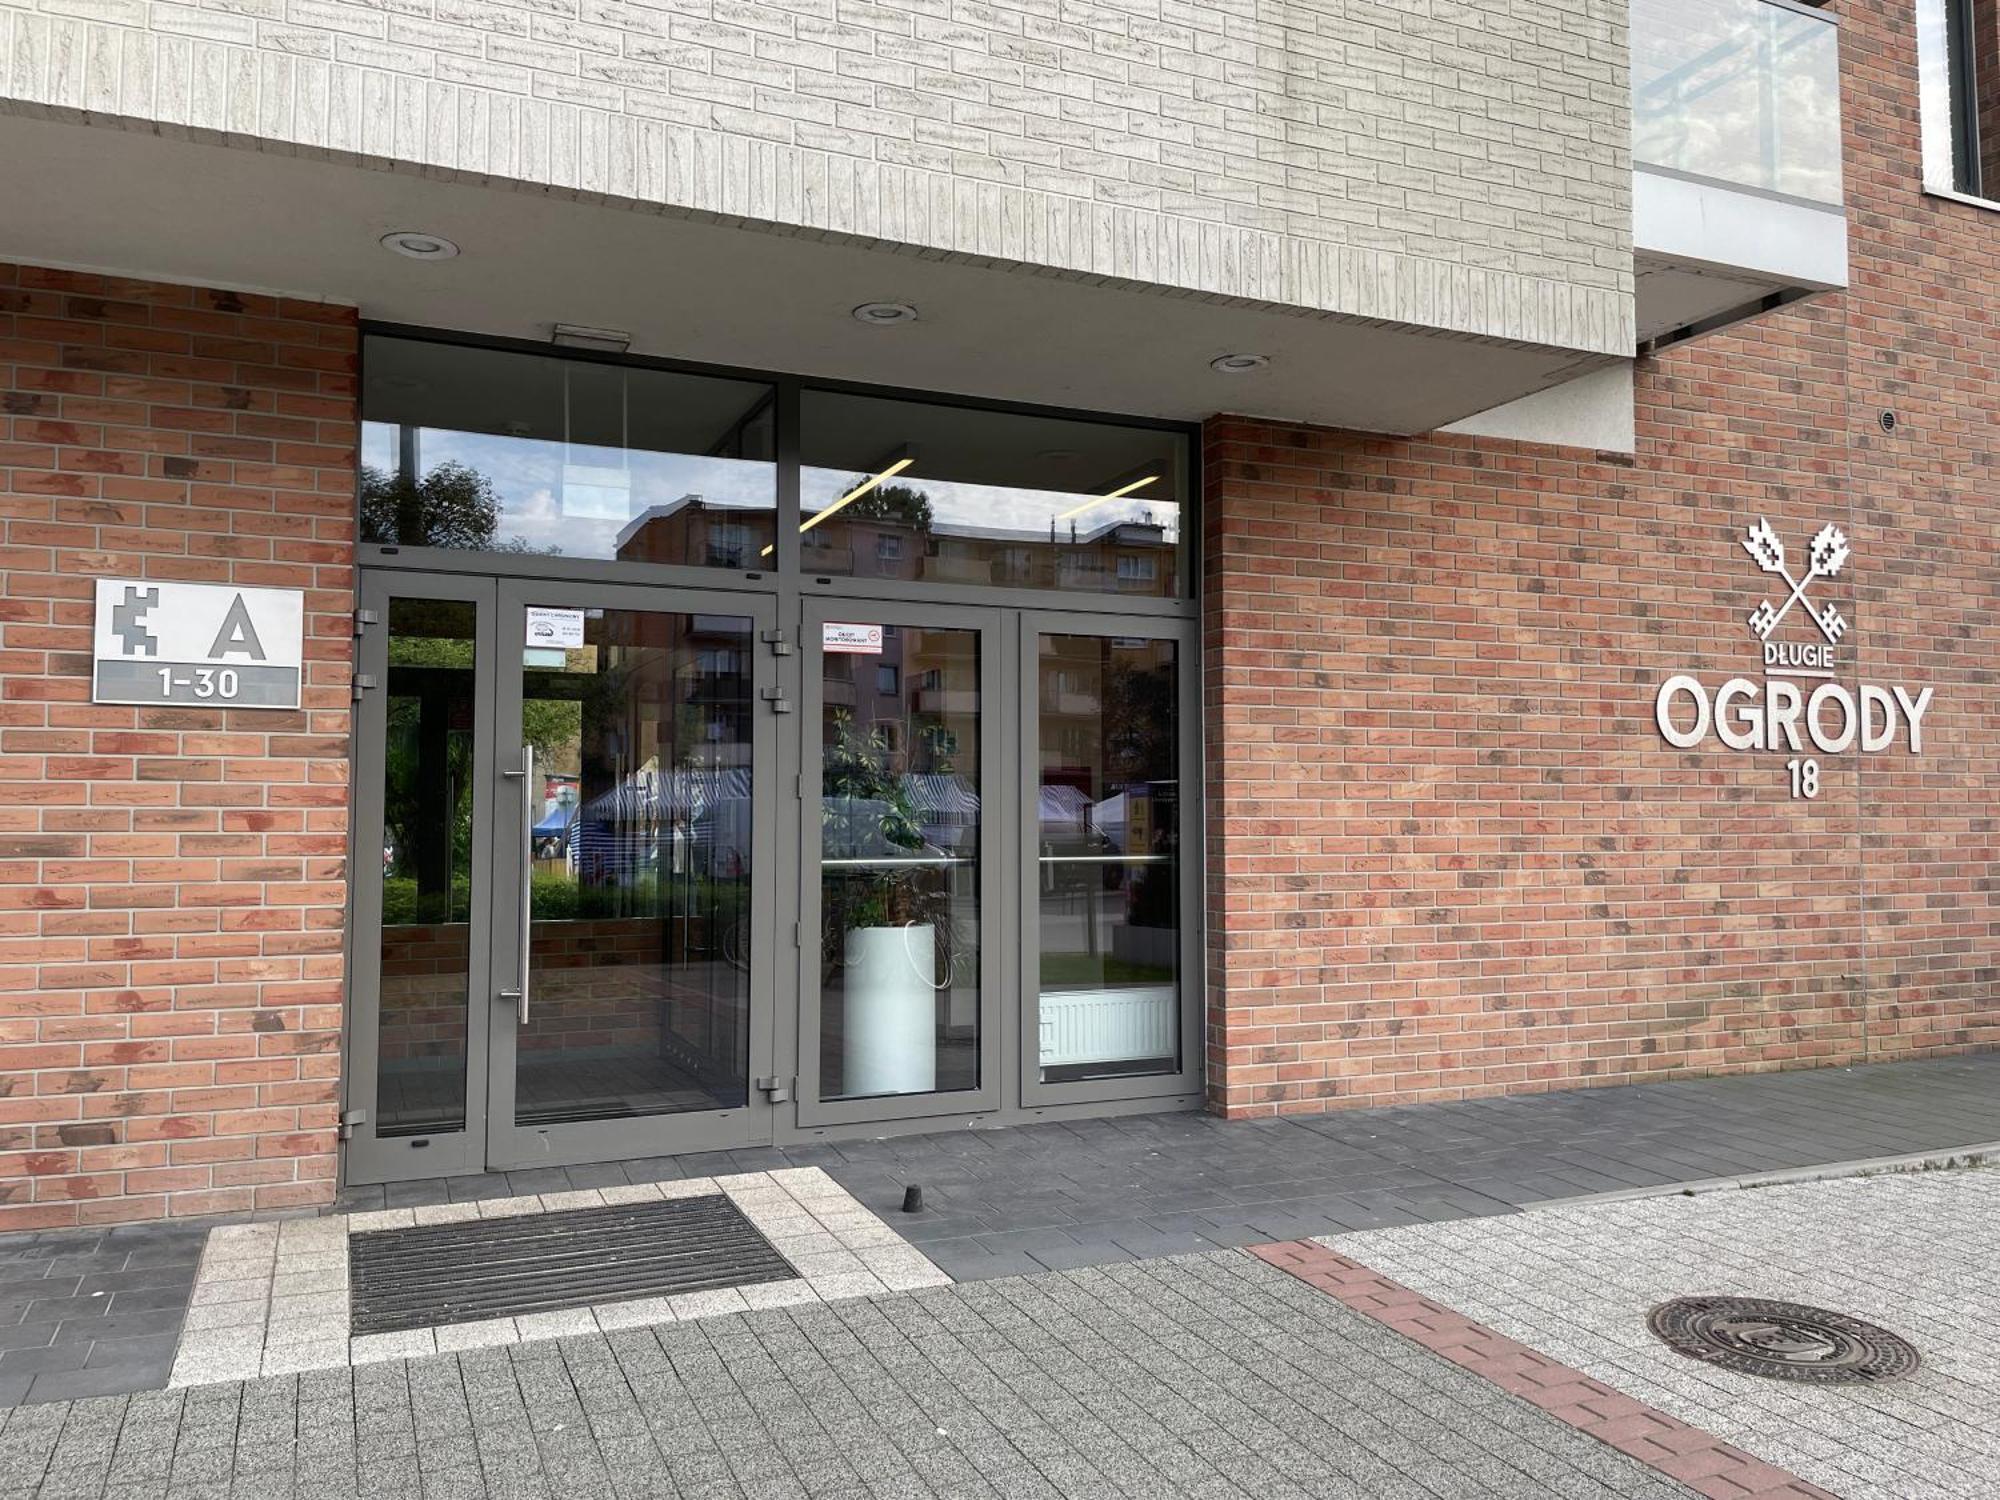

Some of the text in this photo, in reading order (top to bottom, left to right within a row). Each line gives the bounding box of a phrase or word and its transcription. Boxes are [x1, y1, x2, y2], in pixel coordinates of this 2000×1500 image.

[208, 592, 267, 661] A
[1764, 642, 1834, 668] DŁUGIE
[158, 667, 239, 699] 1-30
[1656, 675, 1935, 753] OGRODY
[1787, 759, 1821, 799] 18
